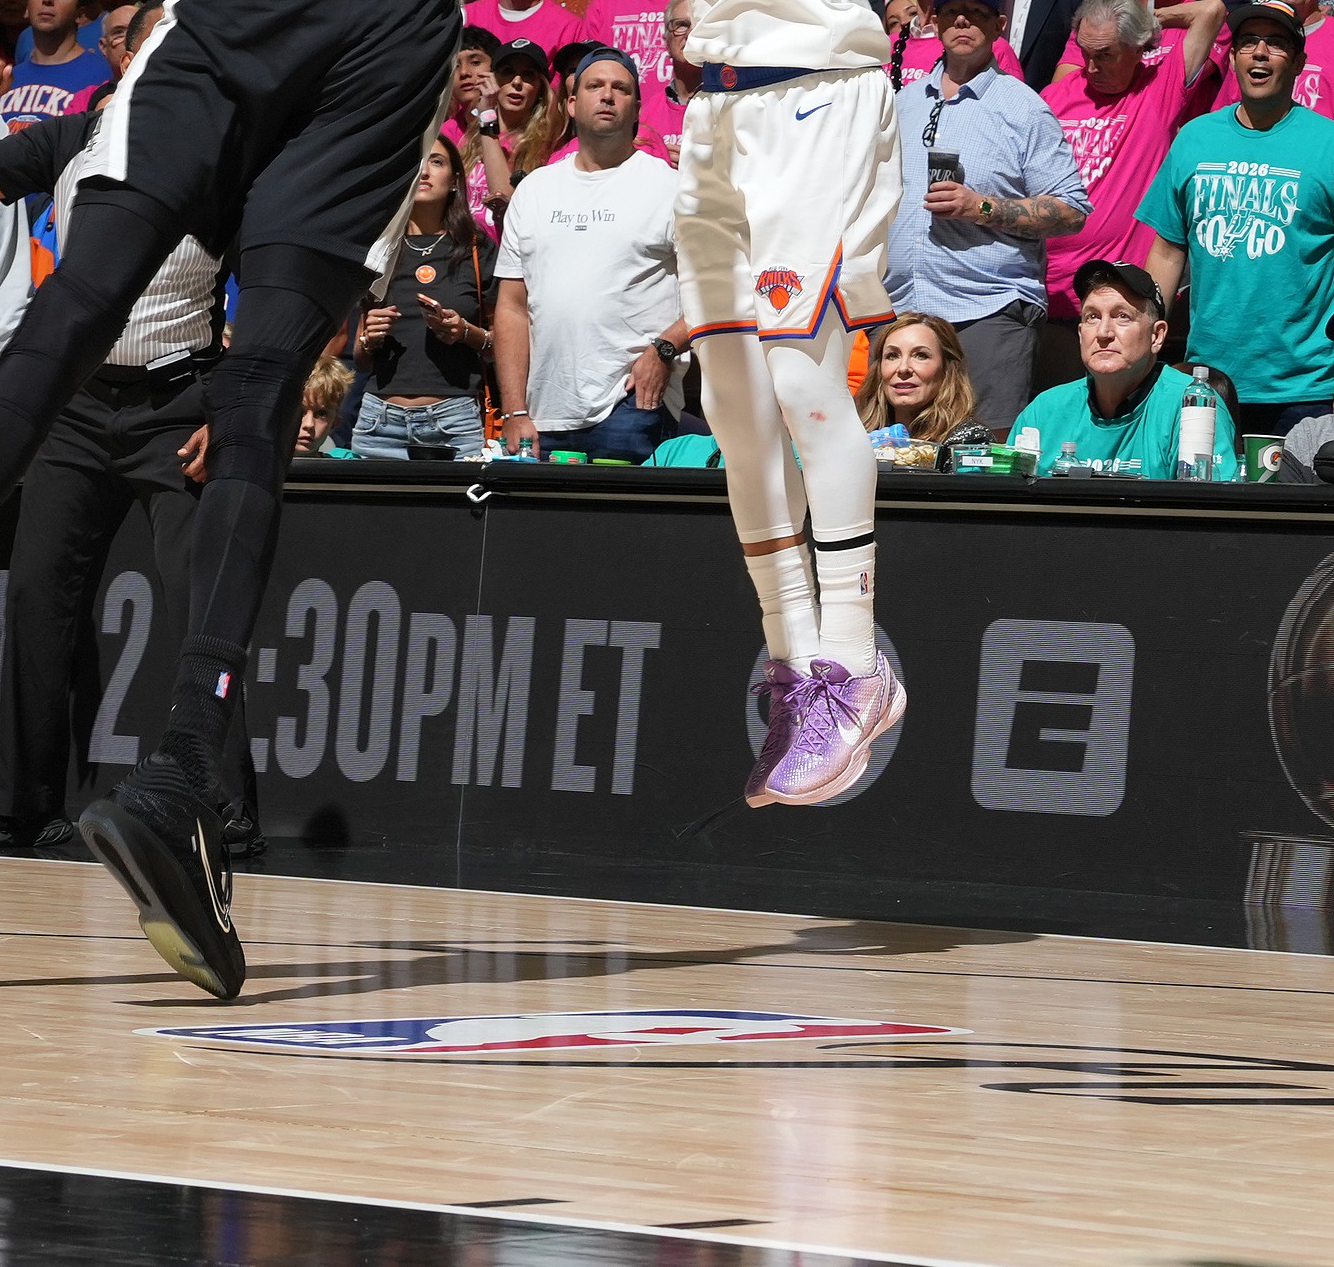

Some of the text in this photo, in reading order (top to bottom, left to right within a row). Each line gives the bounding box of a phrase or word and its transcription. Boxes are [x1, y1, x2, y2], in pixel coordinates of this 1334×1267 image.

[639, 12, 665, 23] 202
[612, 23, 666, 50] FINA
[662, 134, 683, 146] 202
[1228, 161, 1271, 177] 2026
[1193, 173, 1302, 226] FINALS
[550, 209, 616, 225] Play to Win
[1196, 216, 1286, 259] GO GO
[755, 270, 804, 291] KNICKS
[971, 458, 985, 466] NYK
[250, 578, 536, 789] :30PM
[550, 617, 662, 796] ET
